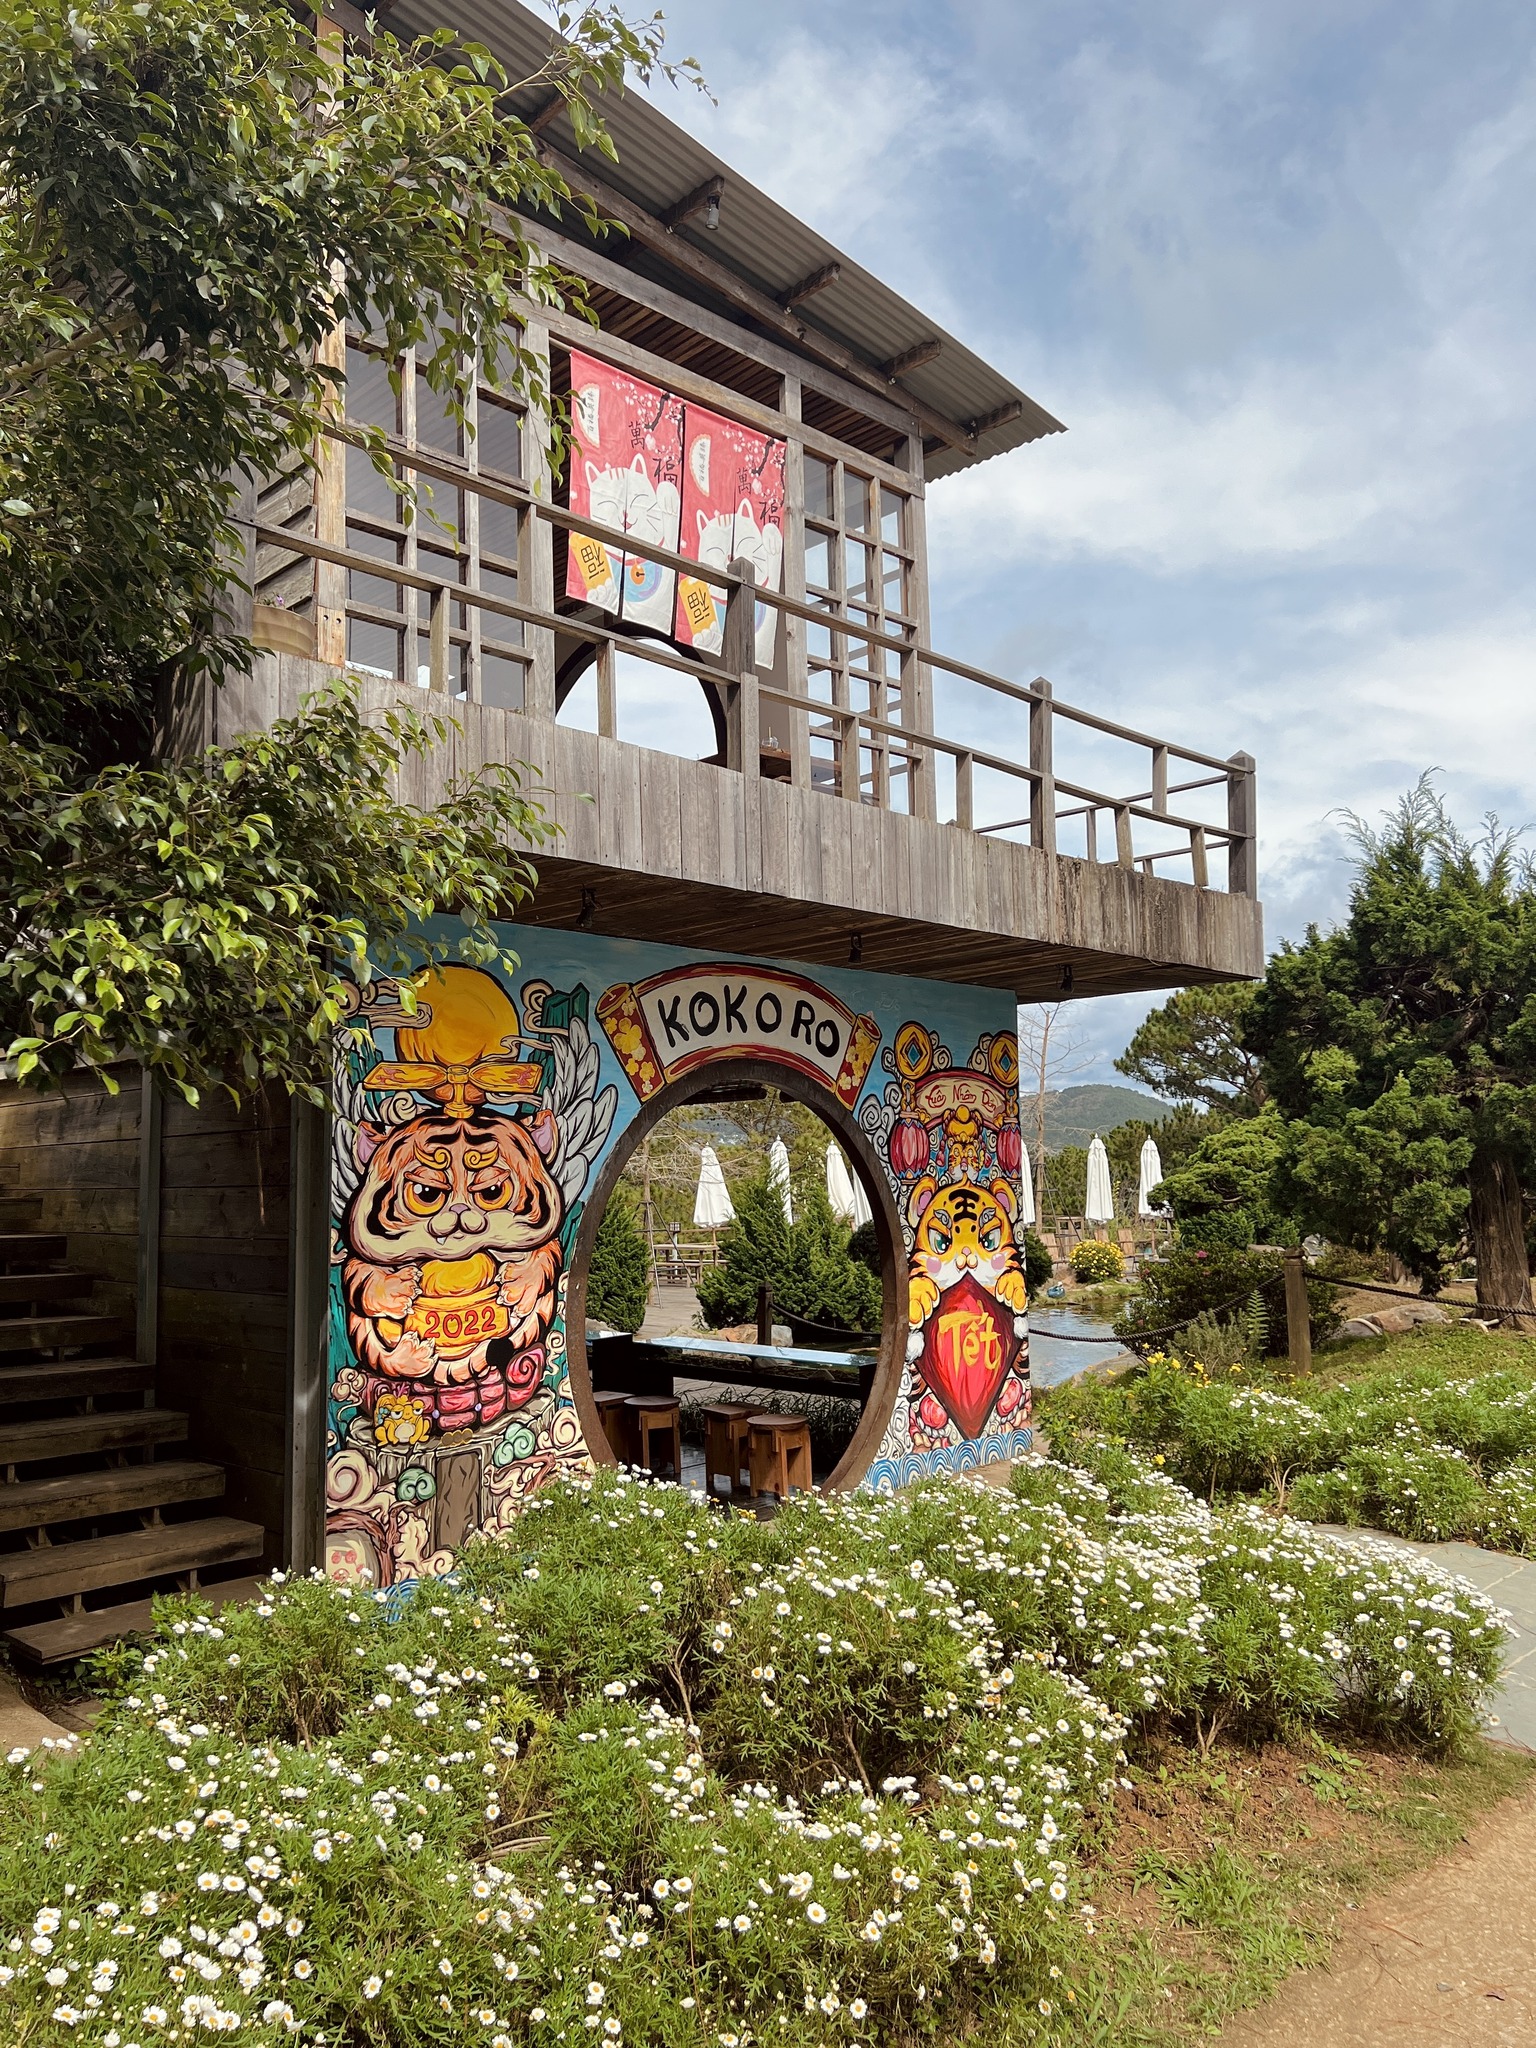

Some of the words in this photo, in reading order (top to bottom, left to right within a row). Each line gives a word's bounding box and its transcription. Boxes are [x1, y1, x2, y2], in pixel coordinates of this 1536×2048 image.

[657, 984, 841, 1058] KOKORO
[424, 1306, 497, 1338] 2022
[938, 1310, 1001, 1380] Tết
